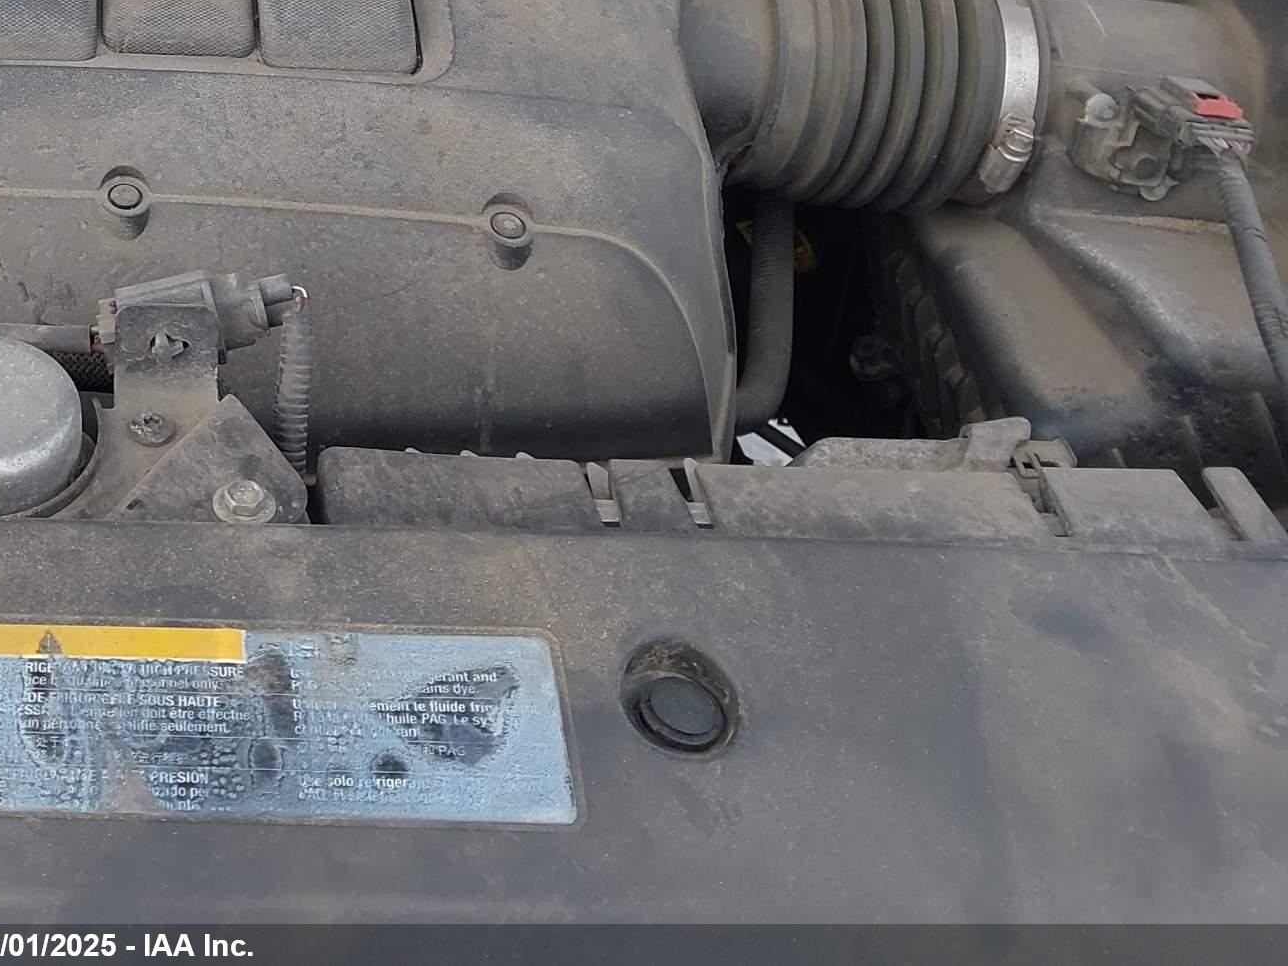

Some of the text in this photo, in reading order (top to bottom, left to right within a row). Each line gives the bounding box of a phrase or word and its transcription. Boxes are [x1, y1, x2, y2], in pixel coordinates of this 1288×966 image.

[472, 672, 498, 683] and
[452, 683, 480, 695] dye.
[178, 695, 222, 708] HAUTE
[414, 701, 427, 713] le
[429, 701, 467, 713] fluide
[169, 706, 195, 720] être
[438, 745, 466, 757] PAG
